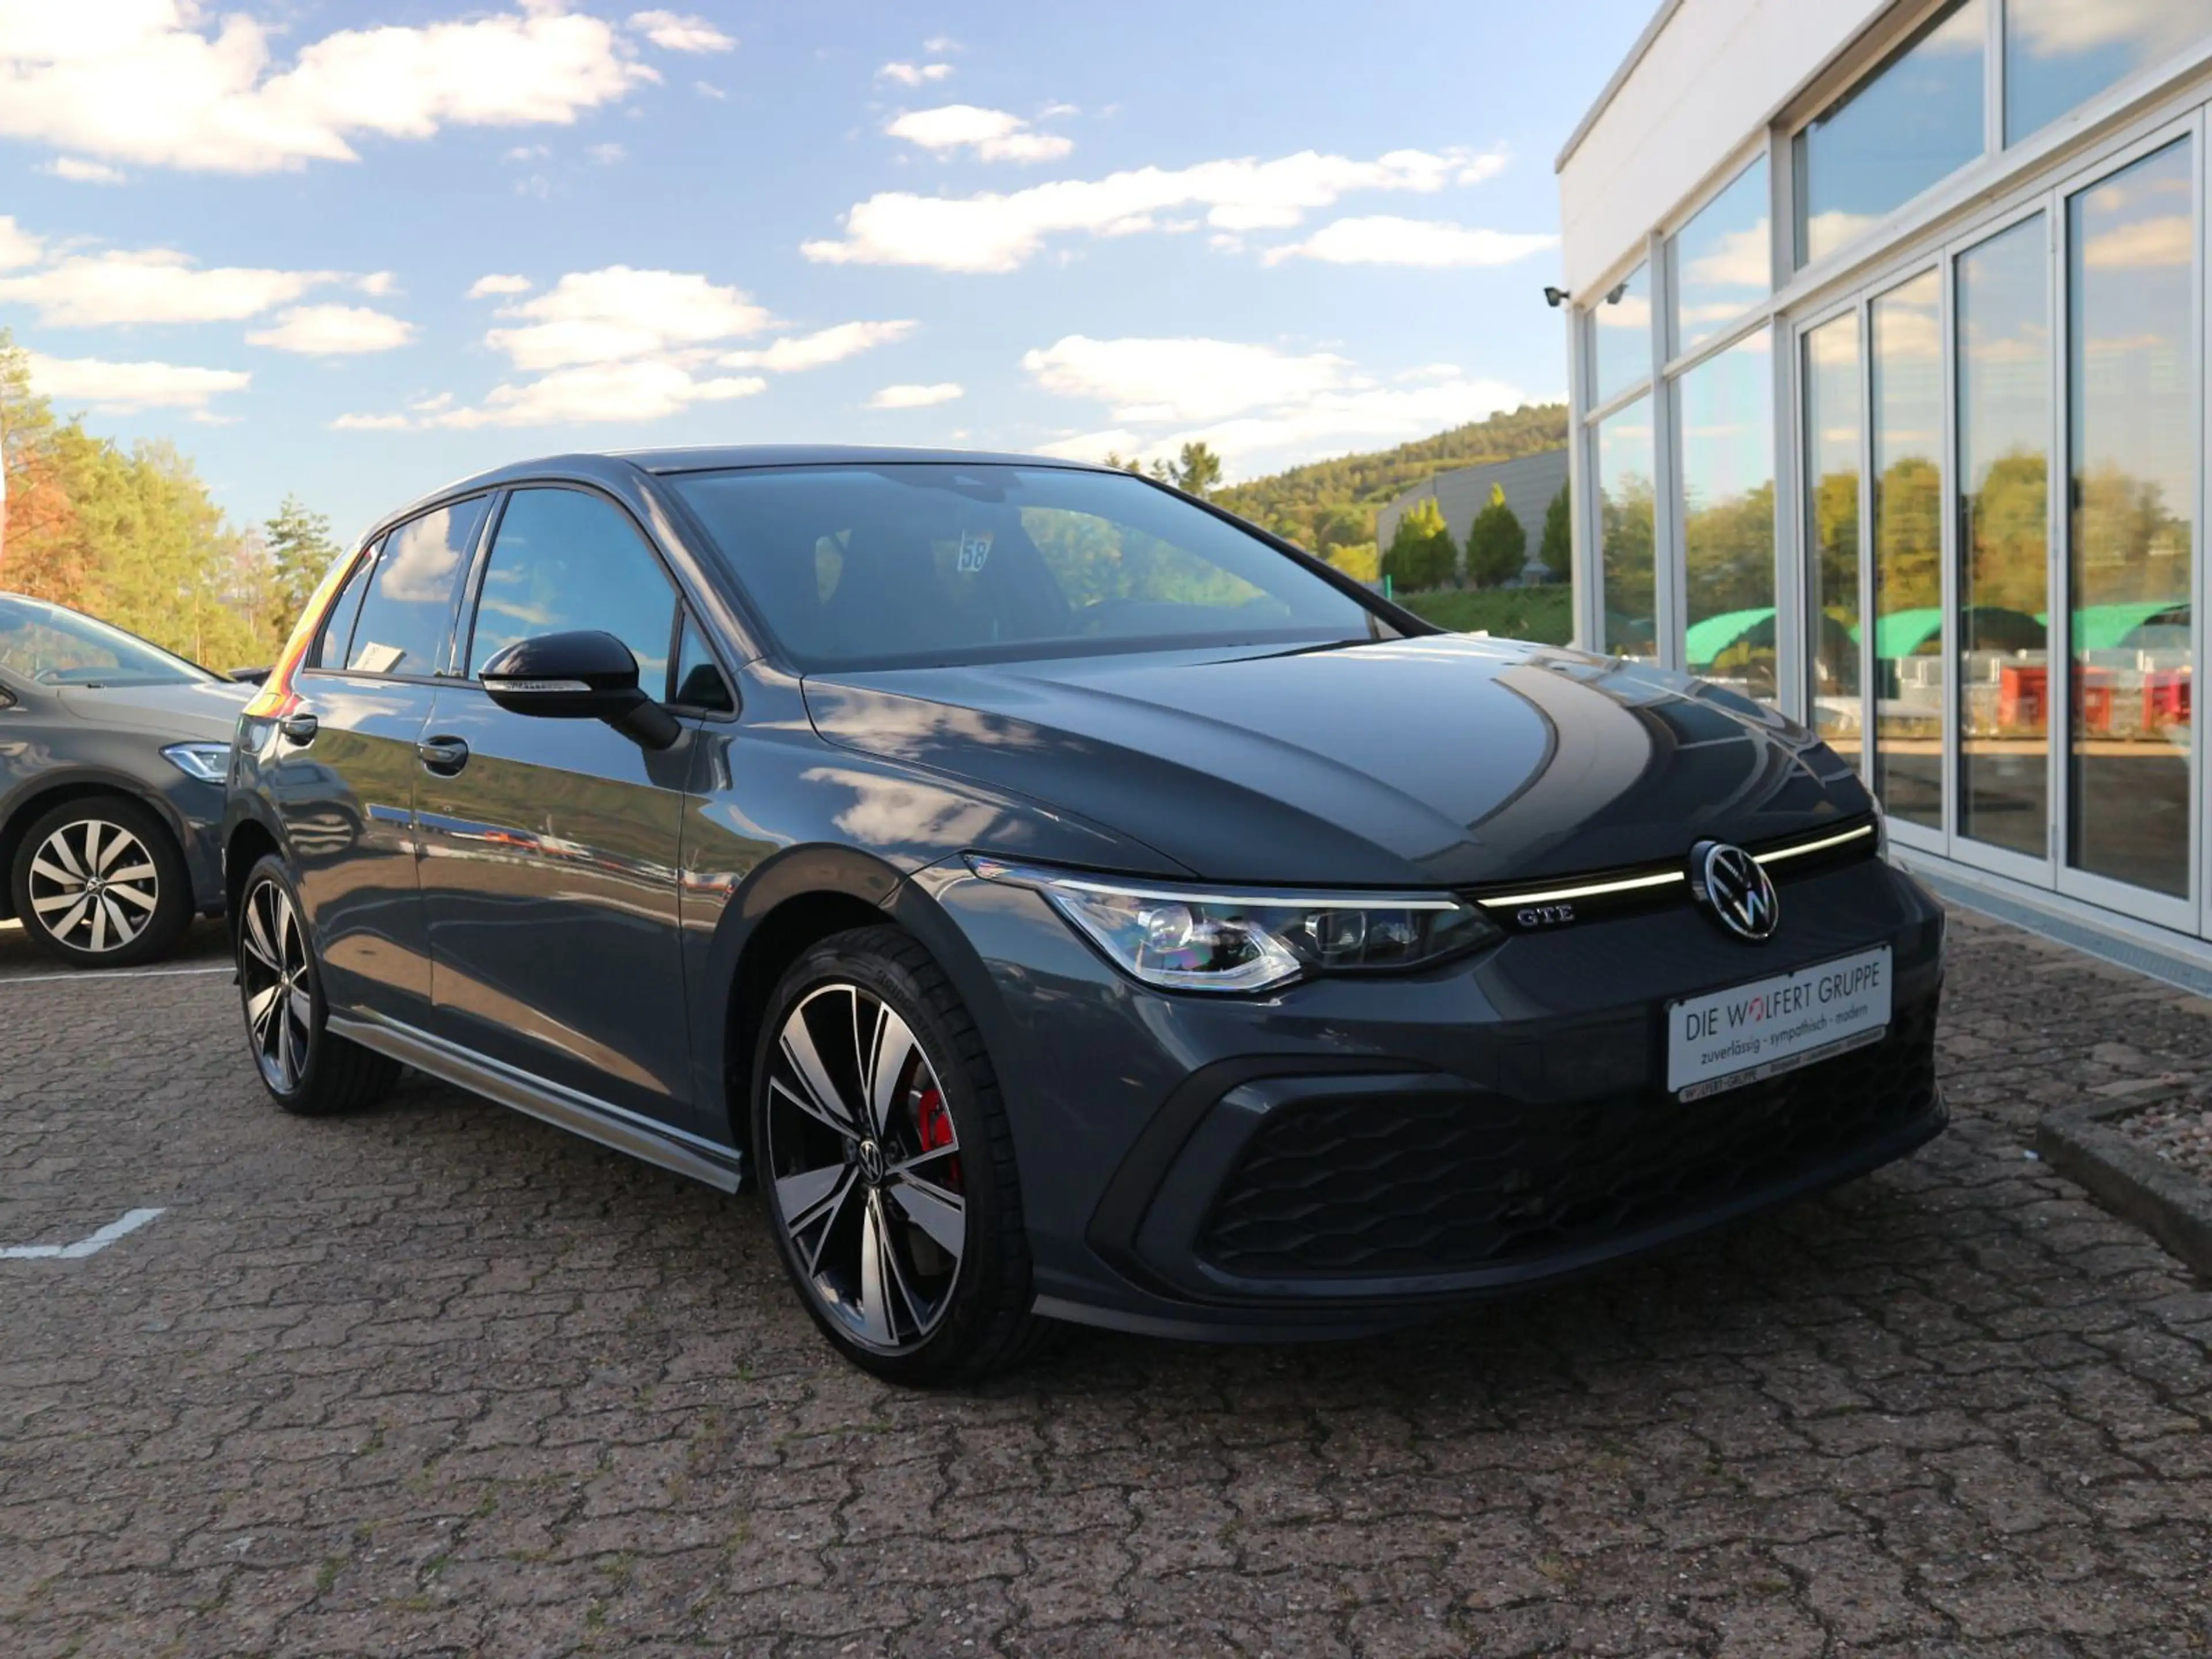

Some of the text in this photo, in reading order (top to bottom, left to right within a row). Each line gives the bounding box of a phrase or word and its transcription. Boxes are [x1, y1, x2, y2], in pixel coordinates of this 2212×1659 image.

[961, 540, 986, 569] 58
[1517, 904, 1575, 927] GTE
[1685, 961, 1880, 1041] DIE WOLFERT GRUPPE
[1700, 1035, 1761, 1066] zuverlässig
[1770, 1013, 1827, 1048] sympathisch
[1835, 1003, 1868, 1025] modern
